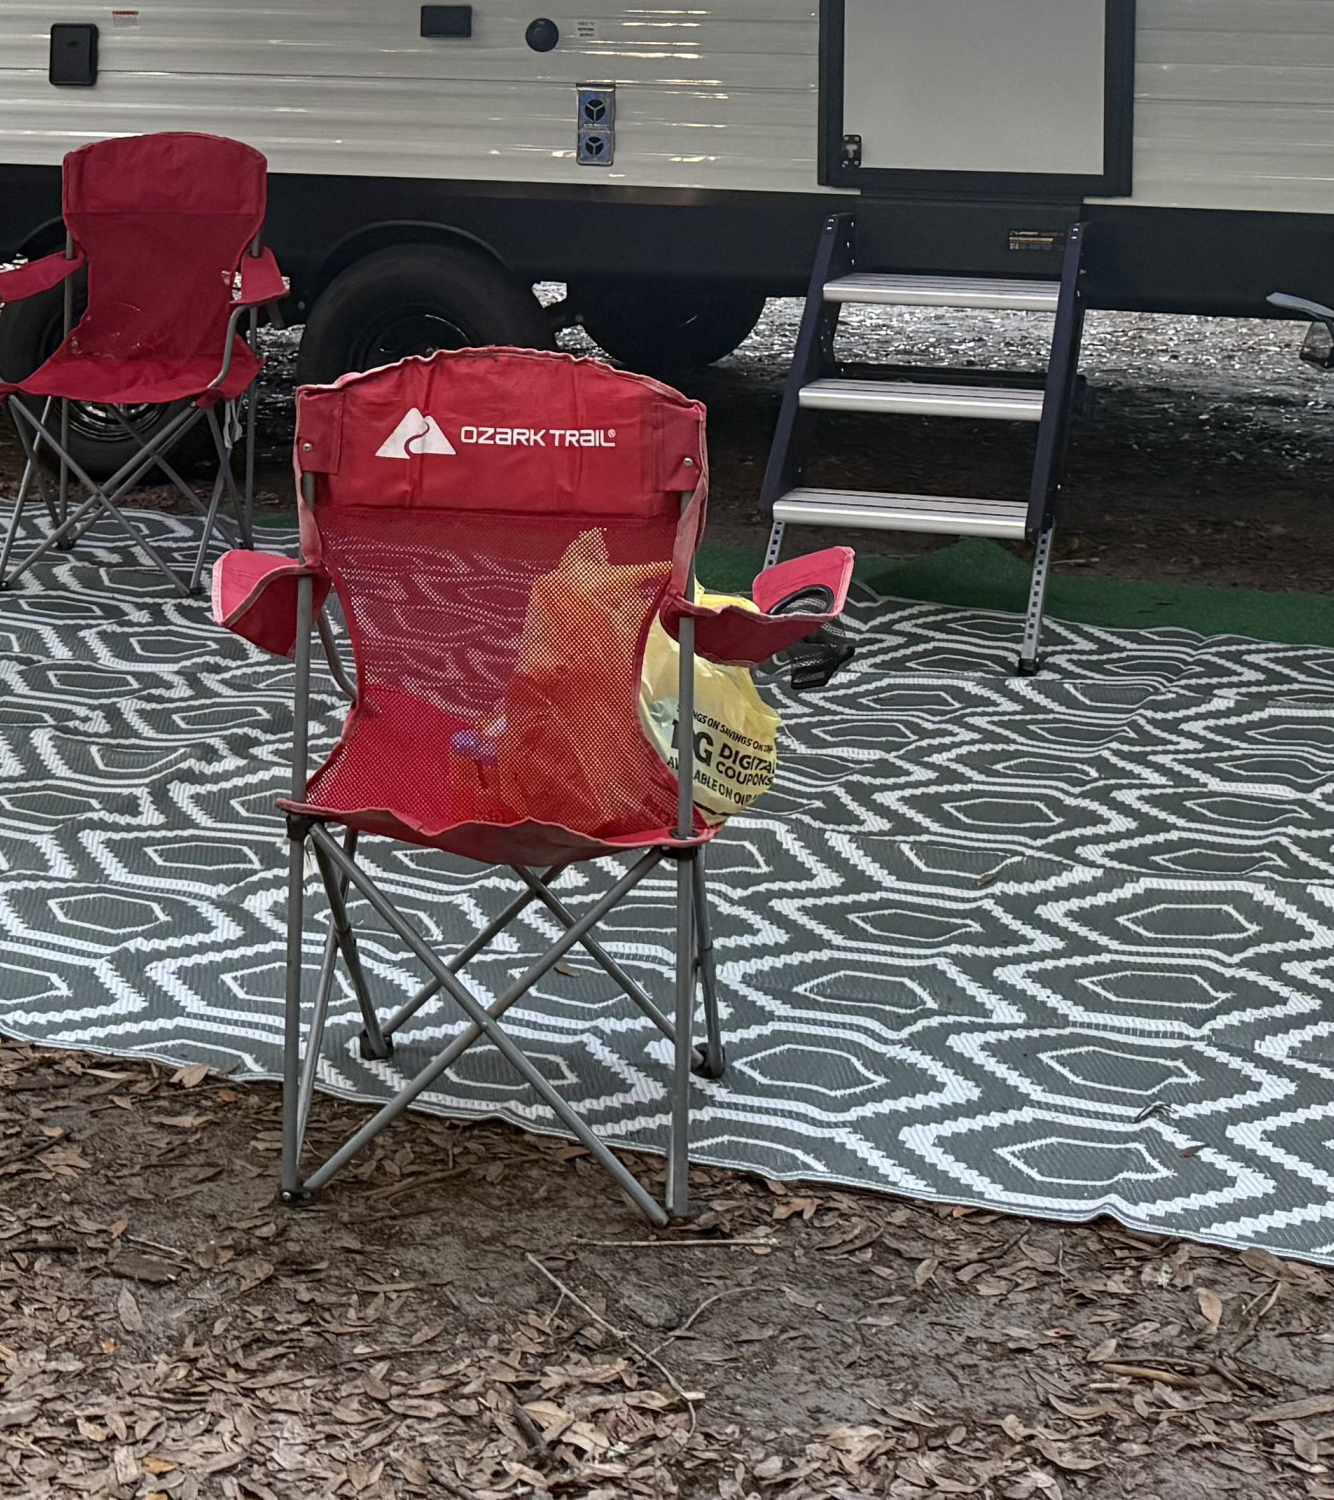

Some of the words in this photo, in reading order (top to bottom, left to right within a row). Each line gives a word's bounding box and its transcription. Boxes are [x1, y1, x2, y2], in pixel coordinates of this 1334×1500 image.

[460, 425, 546, 446] OZARK
[708, 718, 720, 731] ON
[716, 761, 774, 786] COUPONS
[719, 783, 733, 800] ON
